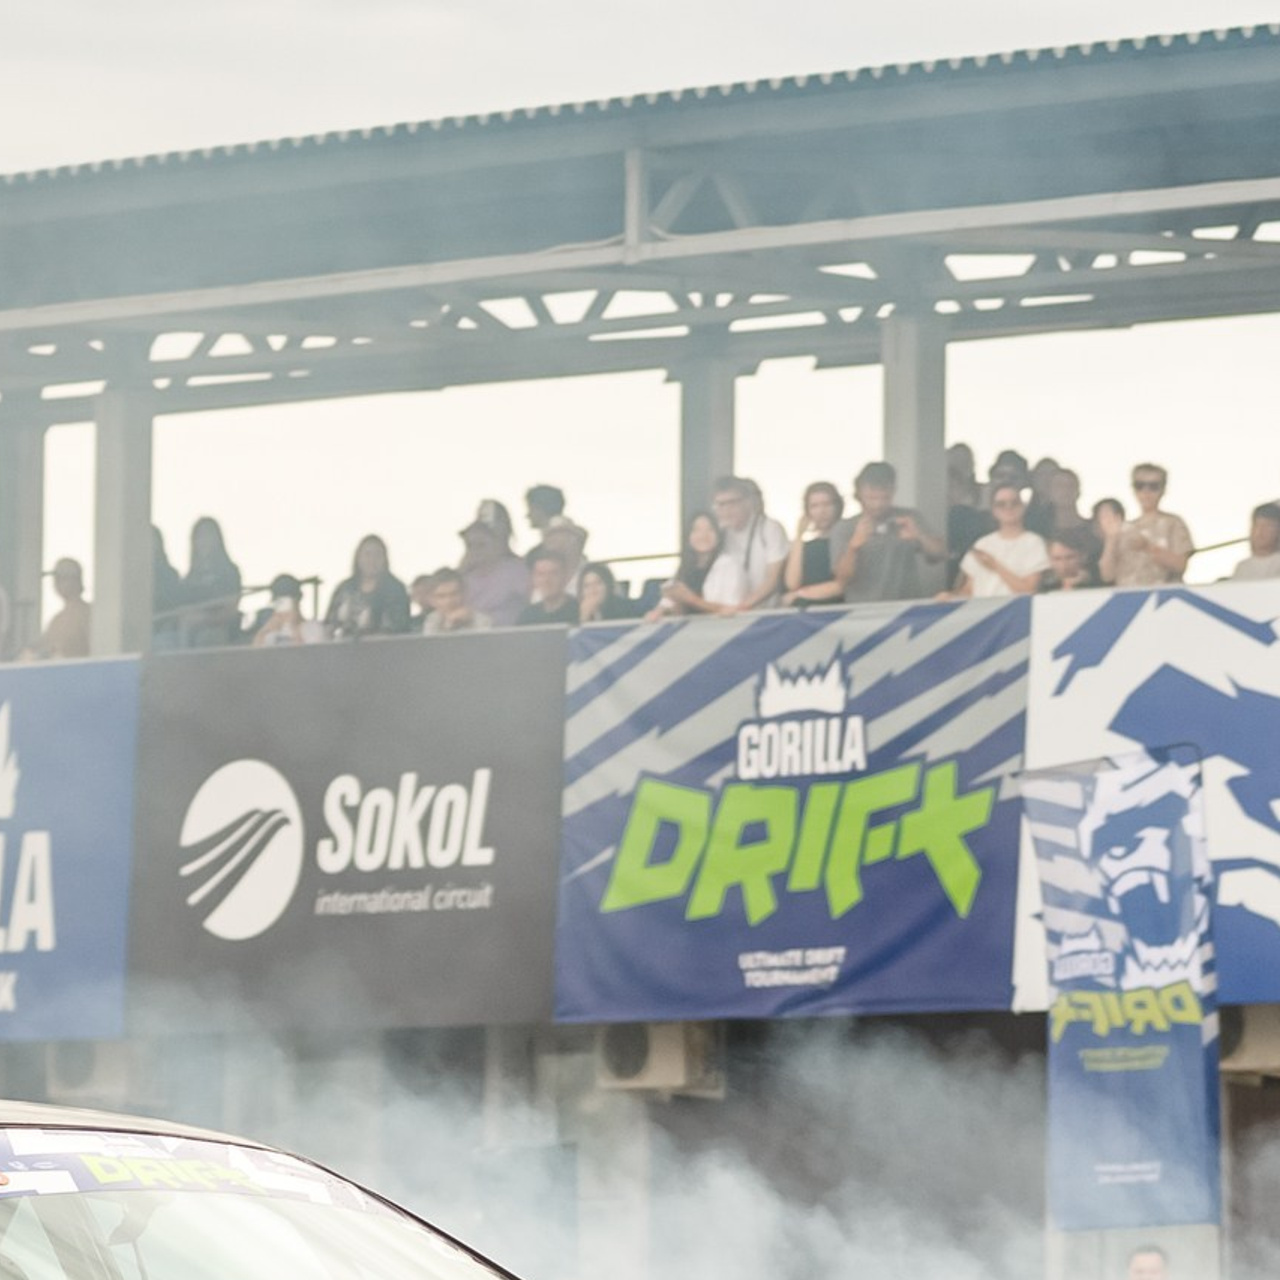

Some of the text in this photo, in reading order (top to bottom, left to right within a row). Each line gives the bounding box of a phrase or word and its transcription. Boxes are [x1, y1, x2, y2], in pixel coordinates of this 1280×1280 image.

[738, 715, 866, 780] GORILLA
[601, 761, 995, 926] DRIFT
[315, 883, 493, 915] international circuit
